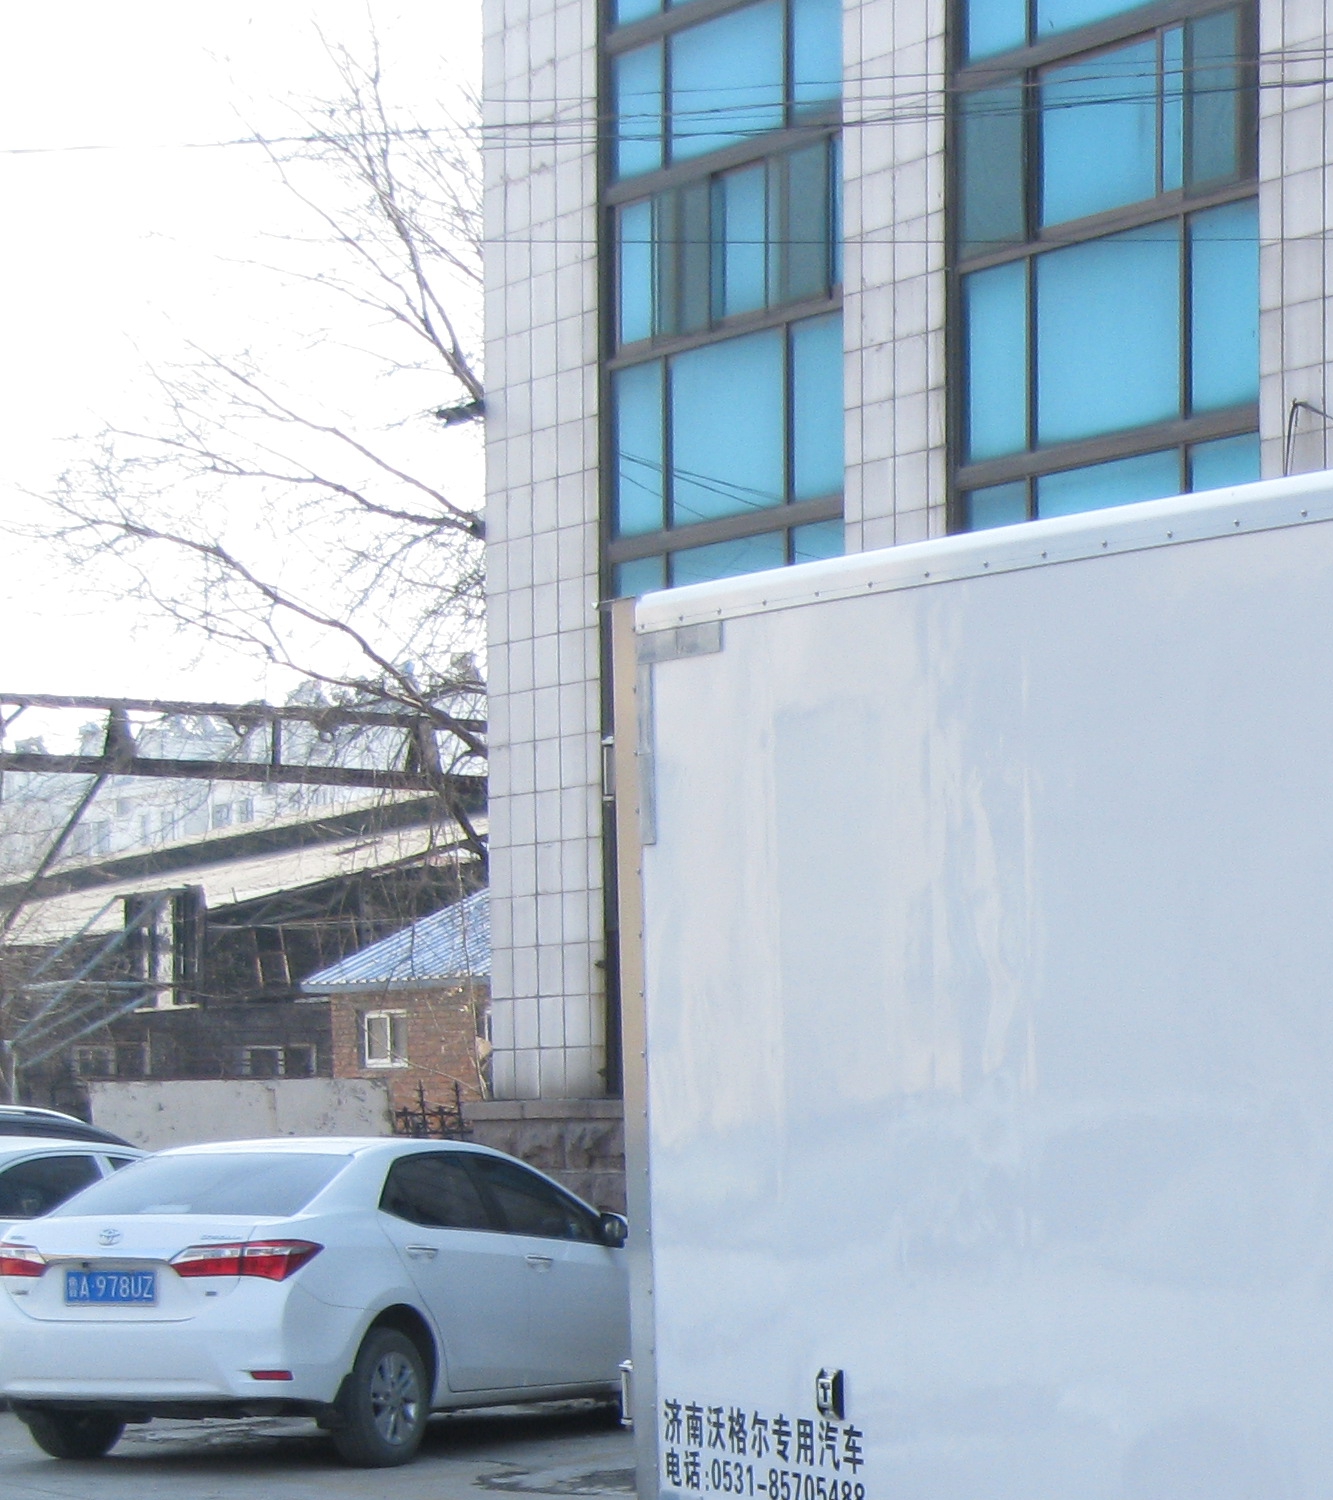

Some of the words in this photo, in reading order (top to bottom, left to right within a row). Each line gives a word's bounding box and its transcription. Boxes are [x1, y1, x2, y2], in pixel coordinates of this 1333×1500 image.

[664, 1398, 865, 1474] 济南沃格尔专用汽车
